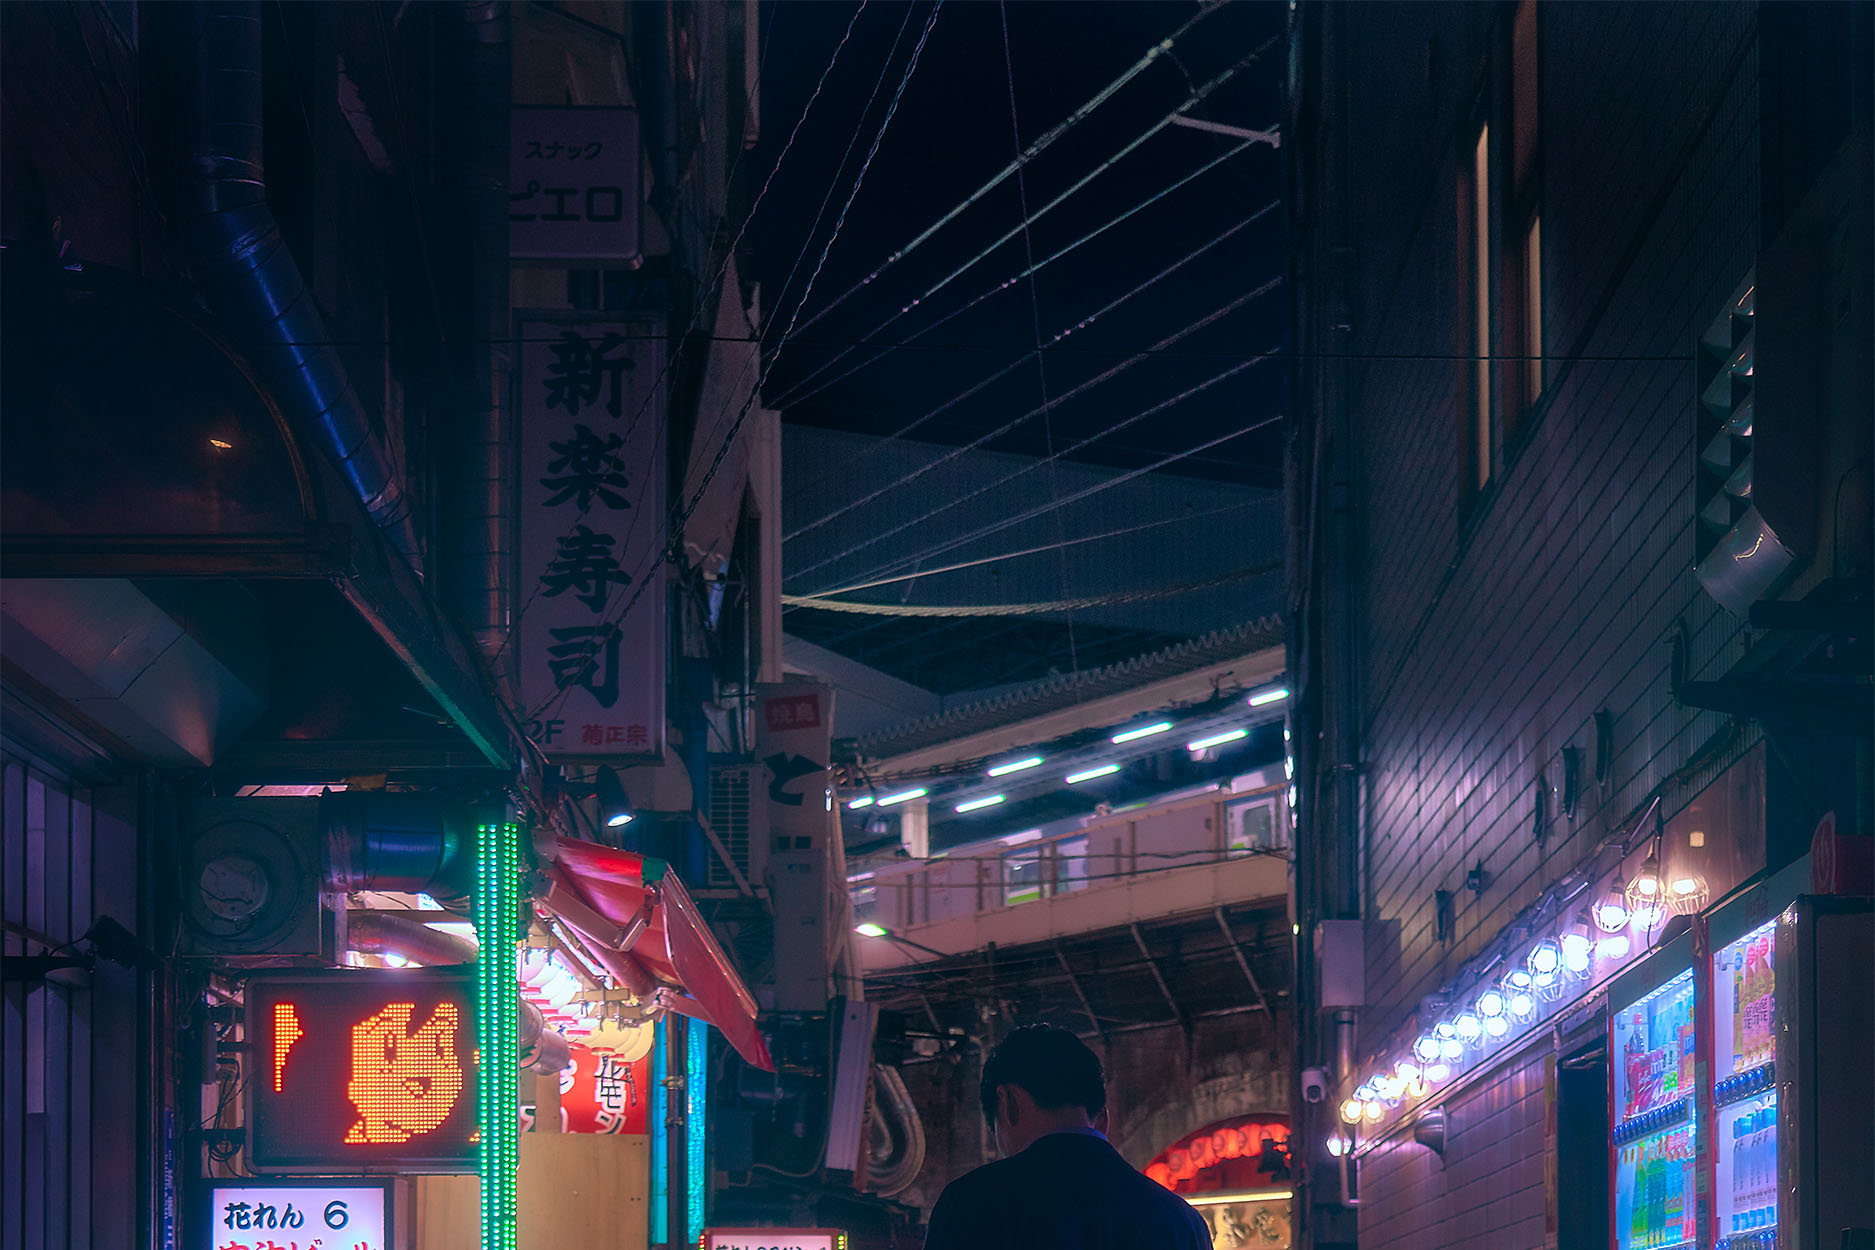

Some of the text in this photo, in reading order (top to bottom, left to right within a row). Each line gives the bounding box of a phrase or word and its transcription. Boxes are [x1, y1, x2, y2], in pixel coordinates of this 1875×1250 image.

[525, 140, 602, 160] スナック
[508, 180, 622, 222] ピエロ
[540, 331, 635, 708] 新楽寿司
[526, 719, 564, 745] 2F
[581, 724, 648, 746] 菊正宗
[224, 1200, 349, 1230] 花れん 6
